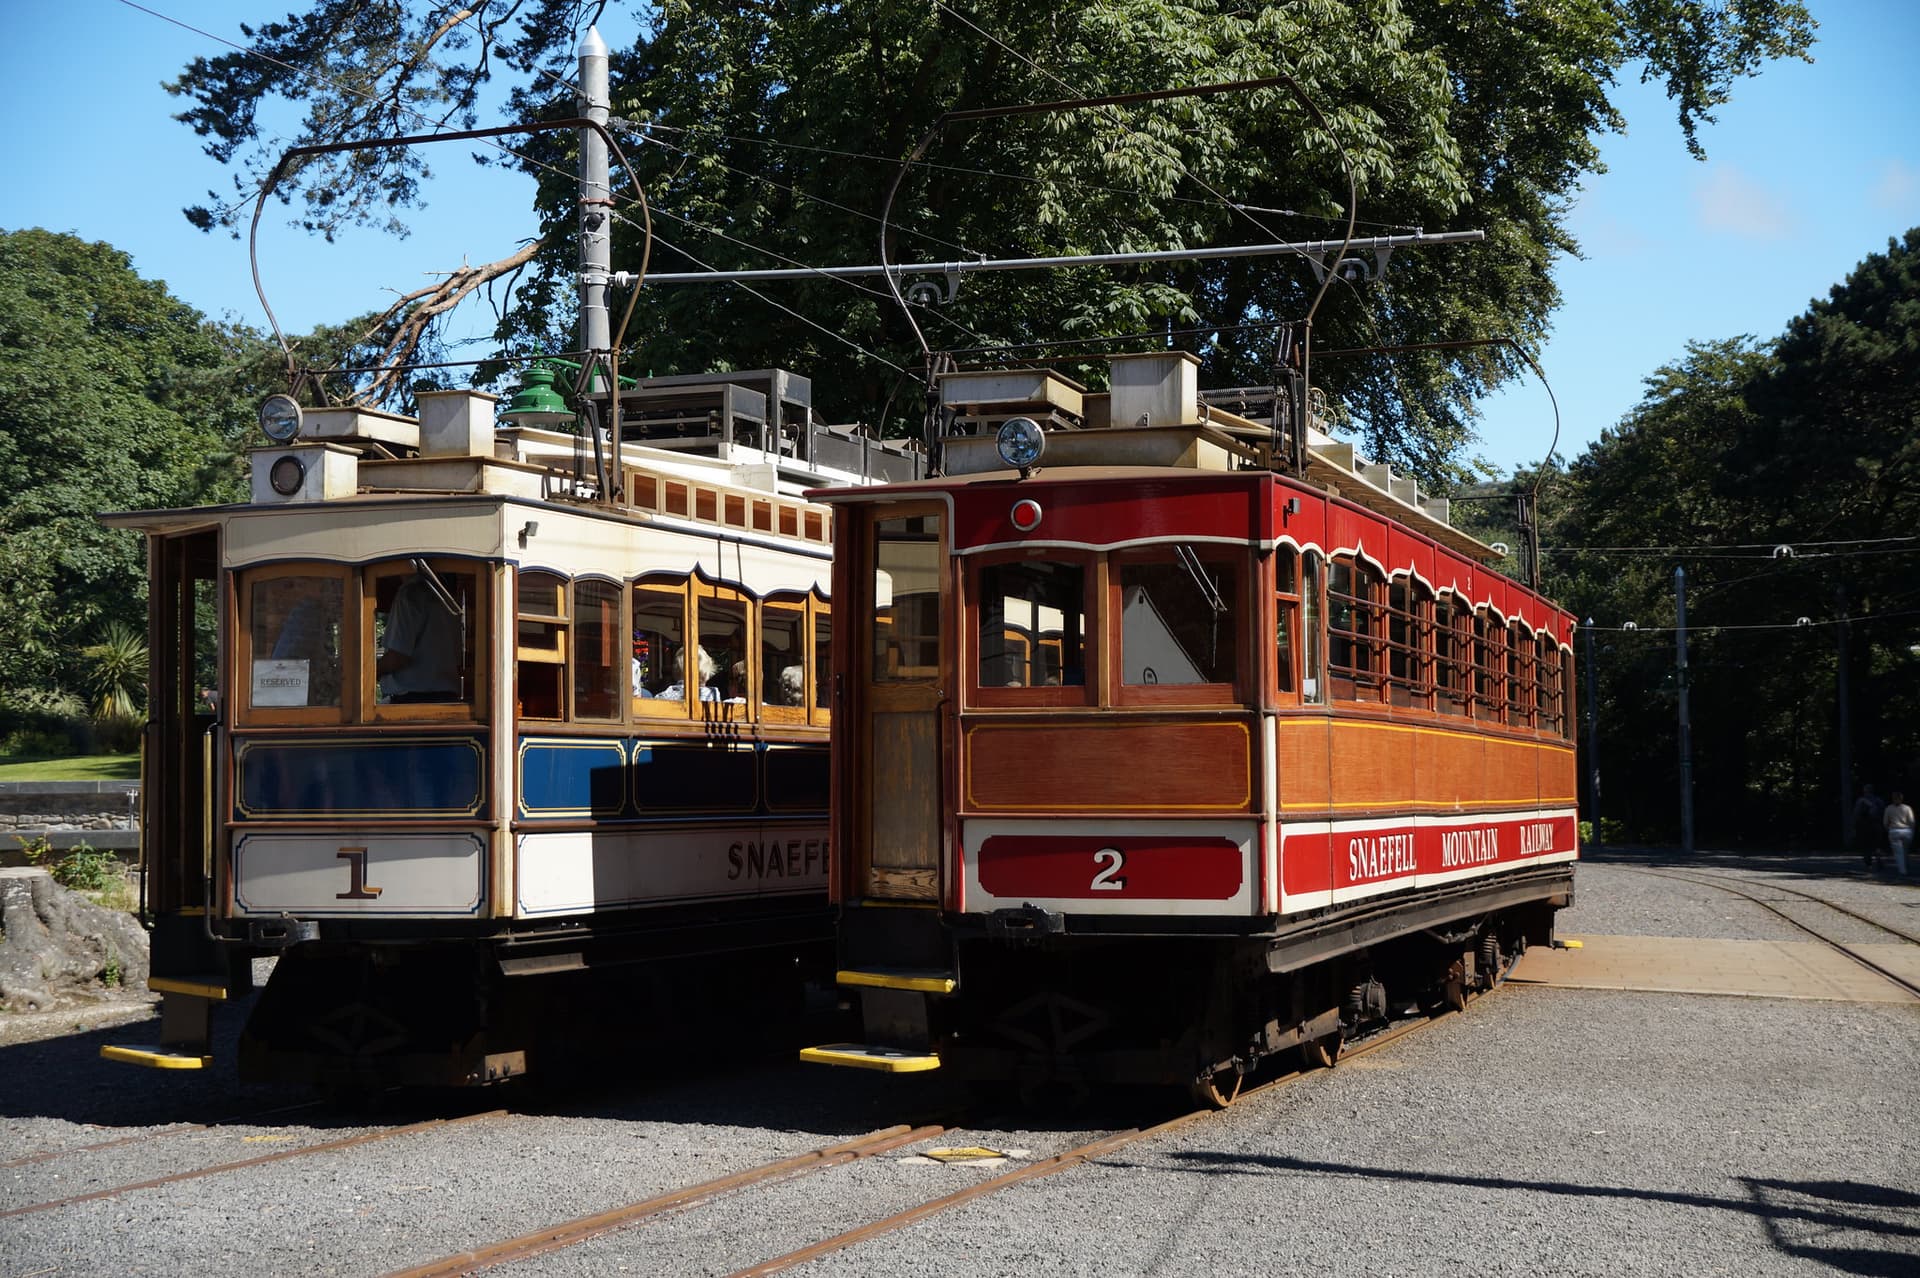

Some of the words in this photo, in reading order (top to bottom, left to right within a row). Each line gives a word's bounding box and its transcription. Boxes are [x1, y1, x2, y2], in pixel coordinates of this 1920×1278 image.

[260, 678, 302, 688] RESERVED
[336, 847, 383, 899] 1
[1090, 848, 1126, 890] 2
[1349, 833, 1417, 881] SNAEFELL
[1441, 827, 1499, 868] MOUNTAIN
[1519, 823, 1554, 855] RAILWAY
